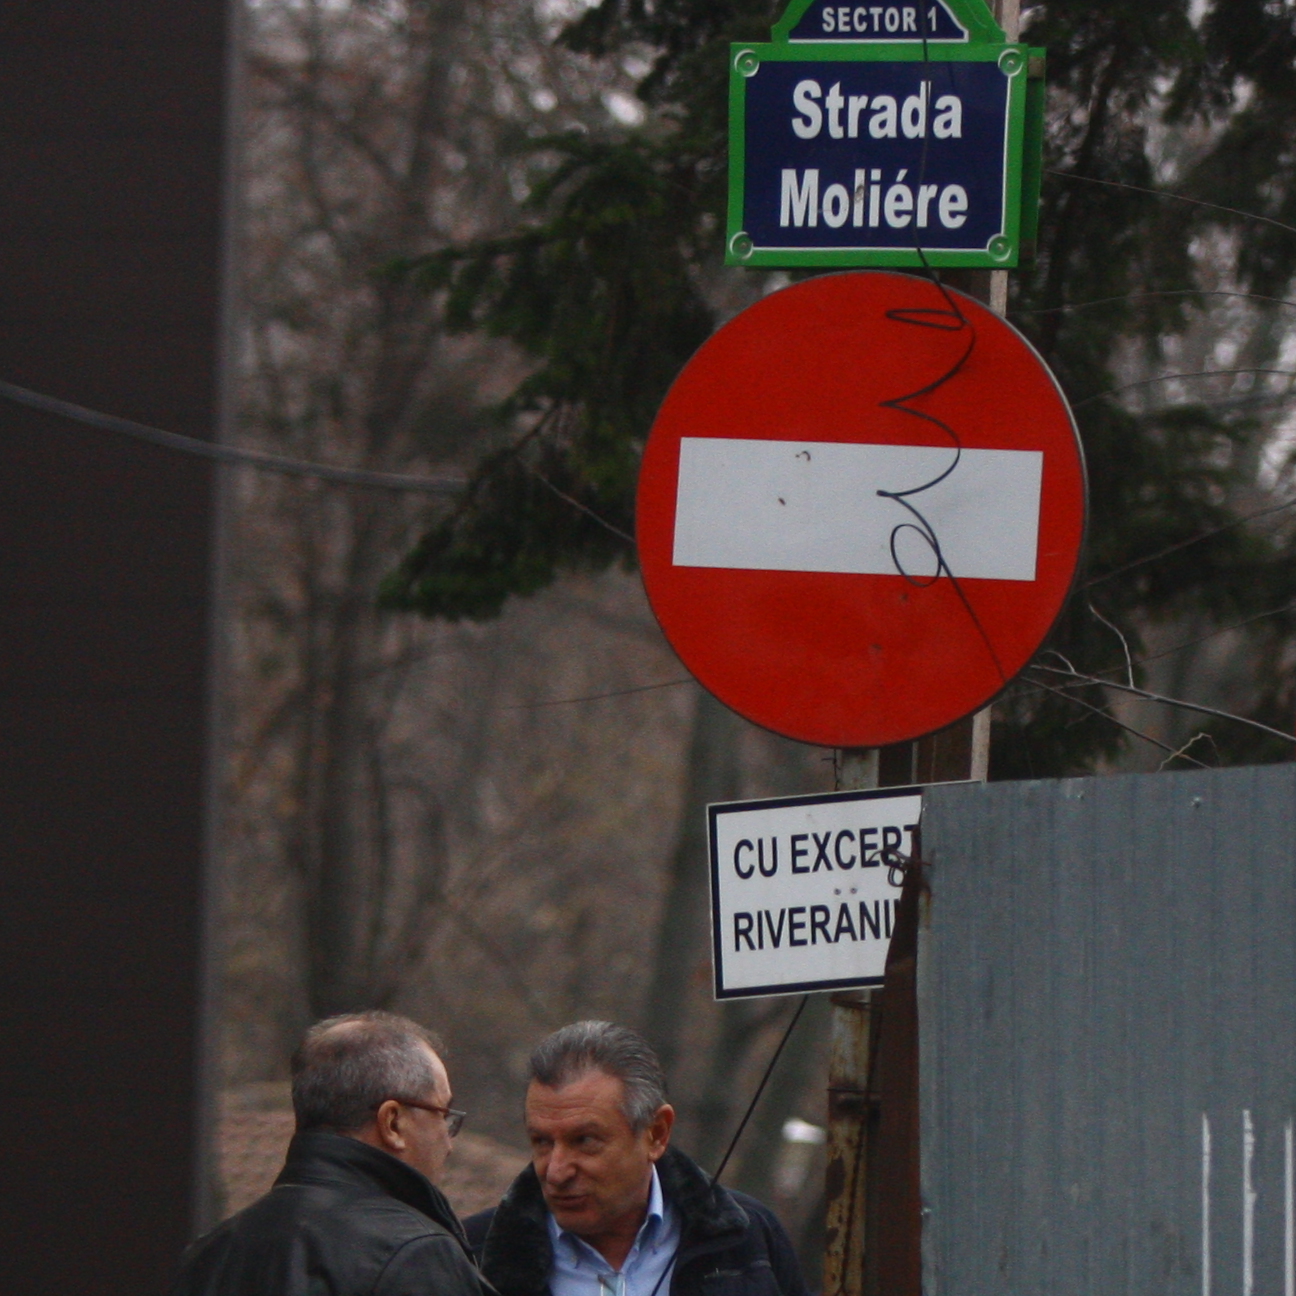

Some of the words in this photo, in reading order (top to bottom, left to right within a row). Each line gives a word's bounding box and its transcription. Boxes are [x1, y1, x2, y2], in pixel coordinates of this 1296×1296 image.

[821, 7, 918, 33] SECTOR
[926, 7, 938, 32] 1
[790, 79, 963, 140] Strada
[779, 168, 969, 229] Moliére
[733, 836, 779, 880] CU
[733, 898, 901, 952] RIVERANI
